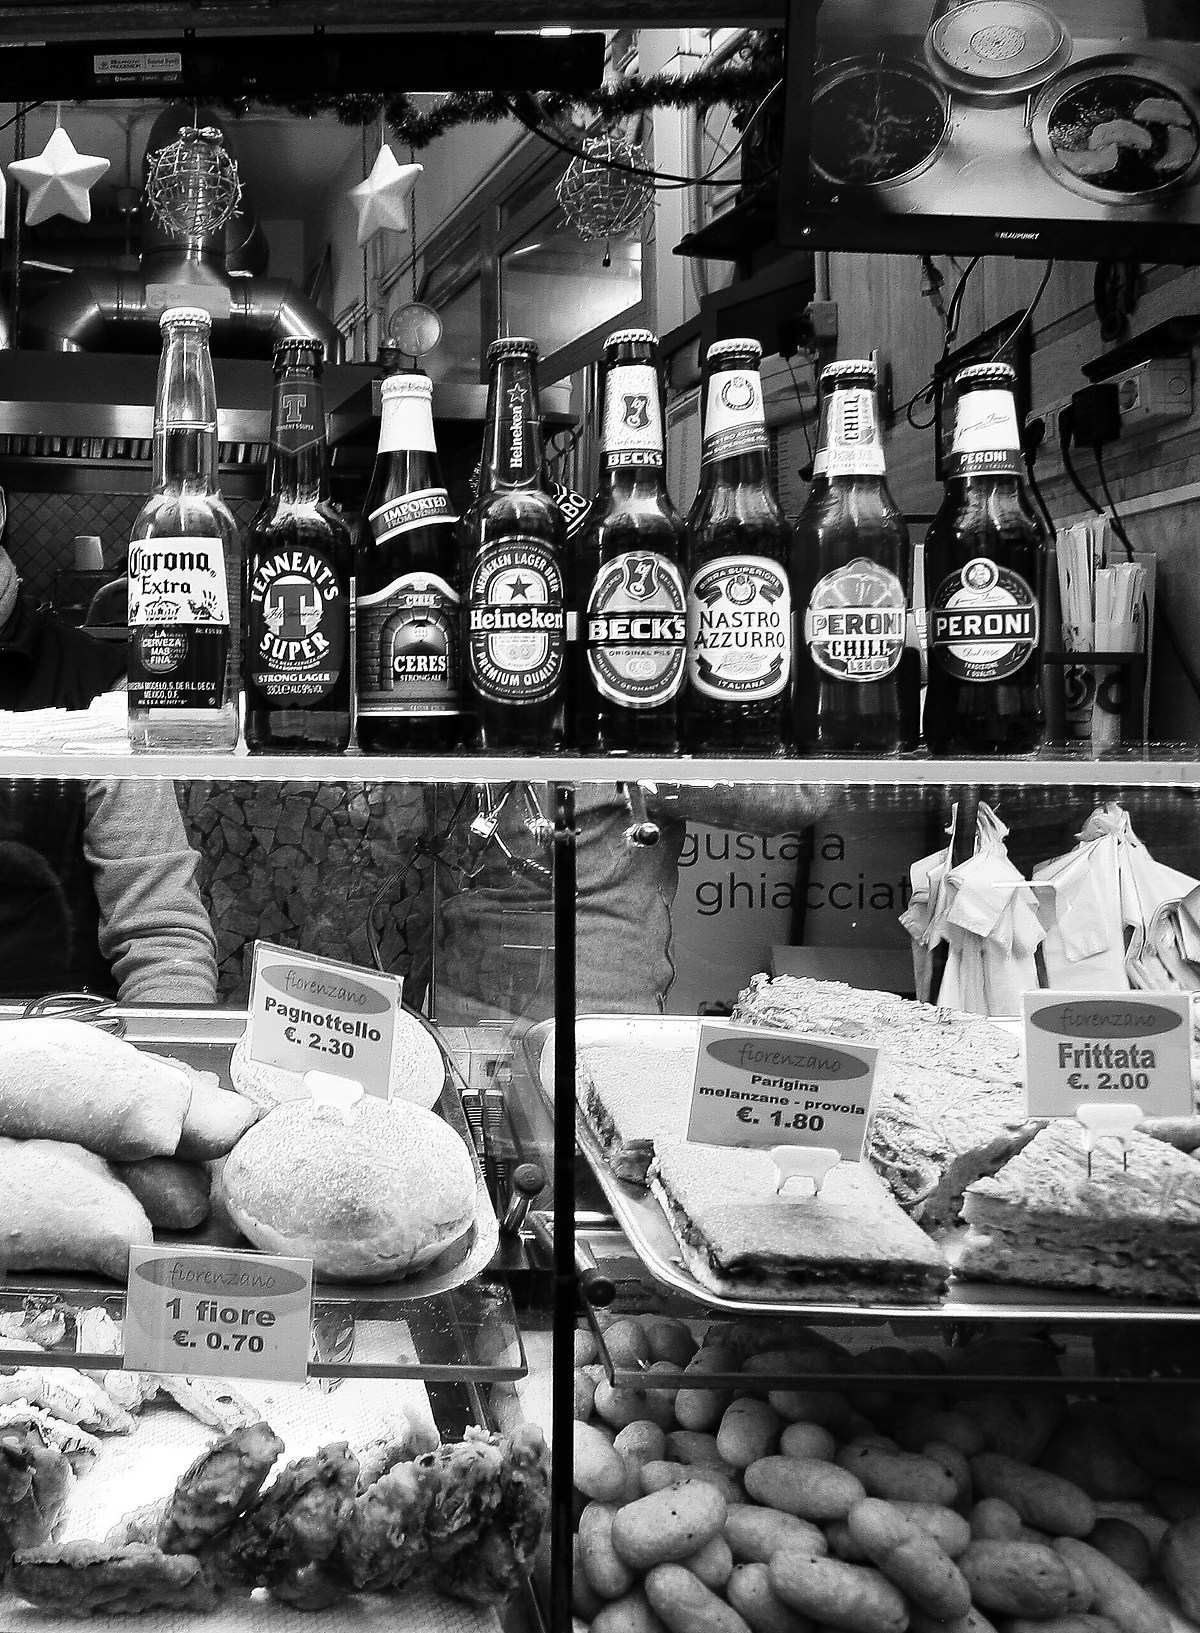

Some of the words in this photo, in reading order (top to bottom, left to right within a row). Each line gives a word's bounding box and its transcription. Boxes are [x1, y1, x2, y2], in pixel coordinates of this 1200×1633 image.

[843, 394, 860, 440] CHILL
[510, 405, 523, 468] Heineken
[607, 452, 663, 467] BECK'S
[960, 450, 1007, 465] PERONI
[383, 496, 447, 523] IMPORTED
[129, 547, 211, 579] Corona
[475, 553, 512, 594] HEINEKEN
[515, 552, 547, 571] LAGER
[141, 574, 192, 596] Extra
[250, 552, 339, 603] TENNENT'S
[469, 608, 563, 630] Heineken
[588, 615, 686, 641] BECK'S
[700, 610, 780, 629] NASTRO
[812, 612, 902, 636] PERONI
[937, 613, 1030, 637] PERONI
[142, 638, 182, 648] CERVEZA
[154, 629, 167, 639] LA
[693, 630, 785, 649] AZZURRO
[260, 632, 330, 661] SUPER
[832, 640, 889, 658] CHILL
[393, 655, 447, 673] CERES
[476, 651, 520, 687] PREMIUM
[523, 651, 559, 686] QUALITY
[258, 673, 298, 683] STRONG
[299, 673, 331, 682] LAGER
[717, 679, 766, 690] ITALIANA
[695, 872, 912, 916] ghiacciat
[284, 969, 368, 1006] fiorenzano
[265, 996, 381, 1042] Pagnottello
[1060, 1008, 1156, 1032] fiorenzano
[308, 1032, 355, 1059] 2.30
[738, 1042, 841, 1073] fiorenzano
[1058, 1042, 1156, 1069] Frittata
[751, 1074, 820, 1093] Parigina
[1097, 1072, 1149, 1090] 2.00
[699, 1085, 790, 1106] melanzane
[804, 1099, 866, 1116] provola
[770, 1109, 825, 1132] 1.80
[169, 1262, 276, 1290] fiorenzano
[166, 1298, 182, 1320] 1
[196, 1300, 276, 1327] fiore
[206, 1332, 264, 1353] 0.70
